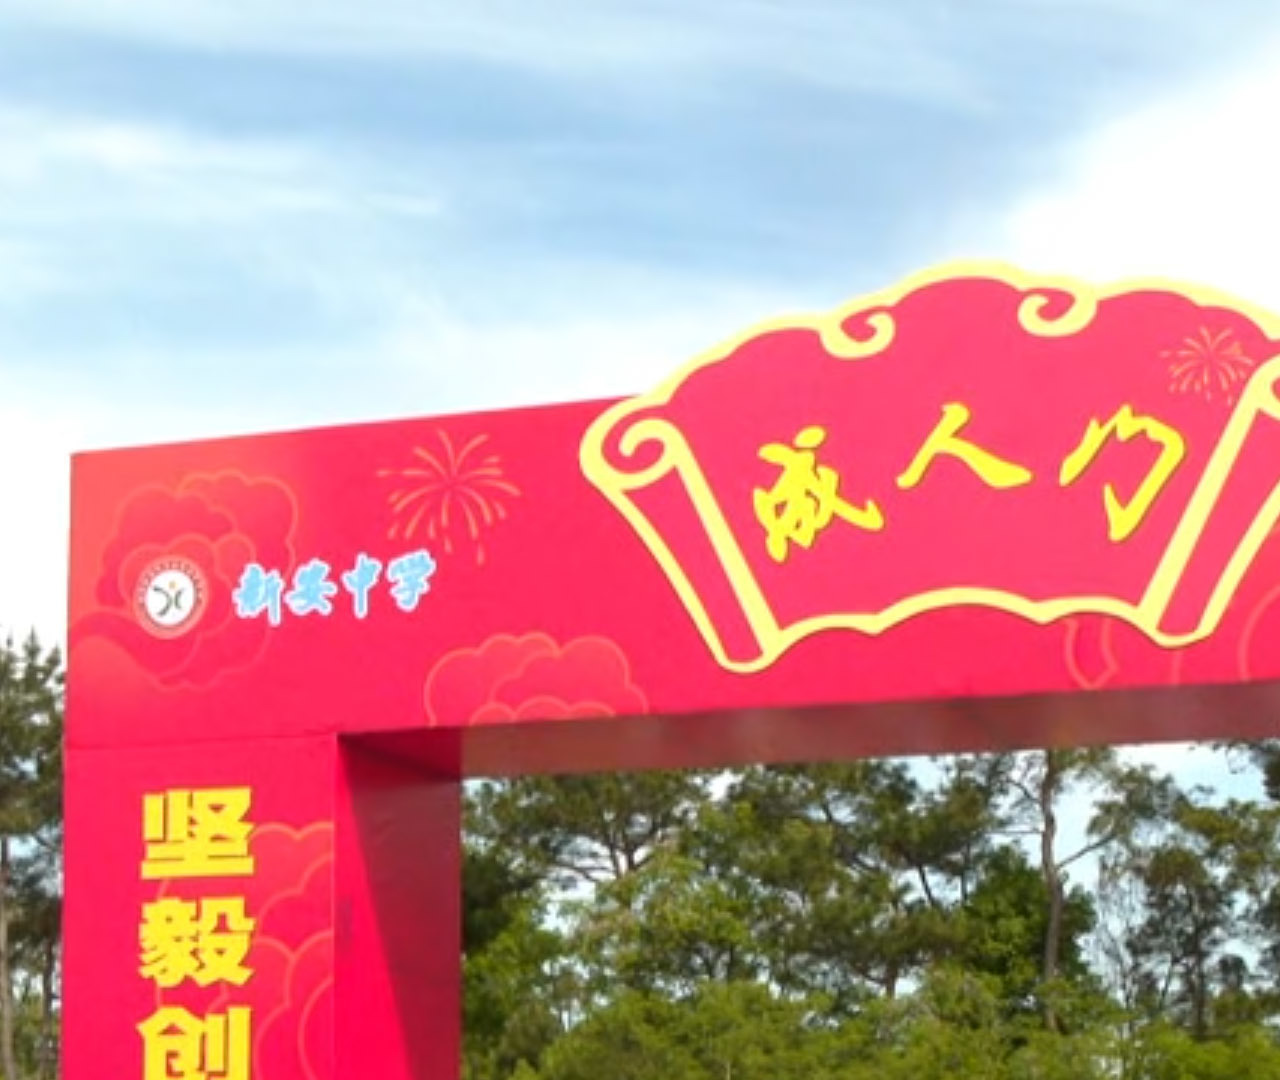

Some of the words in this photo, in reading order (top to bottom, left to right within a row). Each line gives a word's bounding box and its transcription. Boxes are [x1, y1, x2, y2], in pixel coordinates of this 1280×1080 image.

[752, 402, 1186, 564] 成人门
[231, 548, 437, 628] 新安中学
